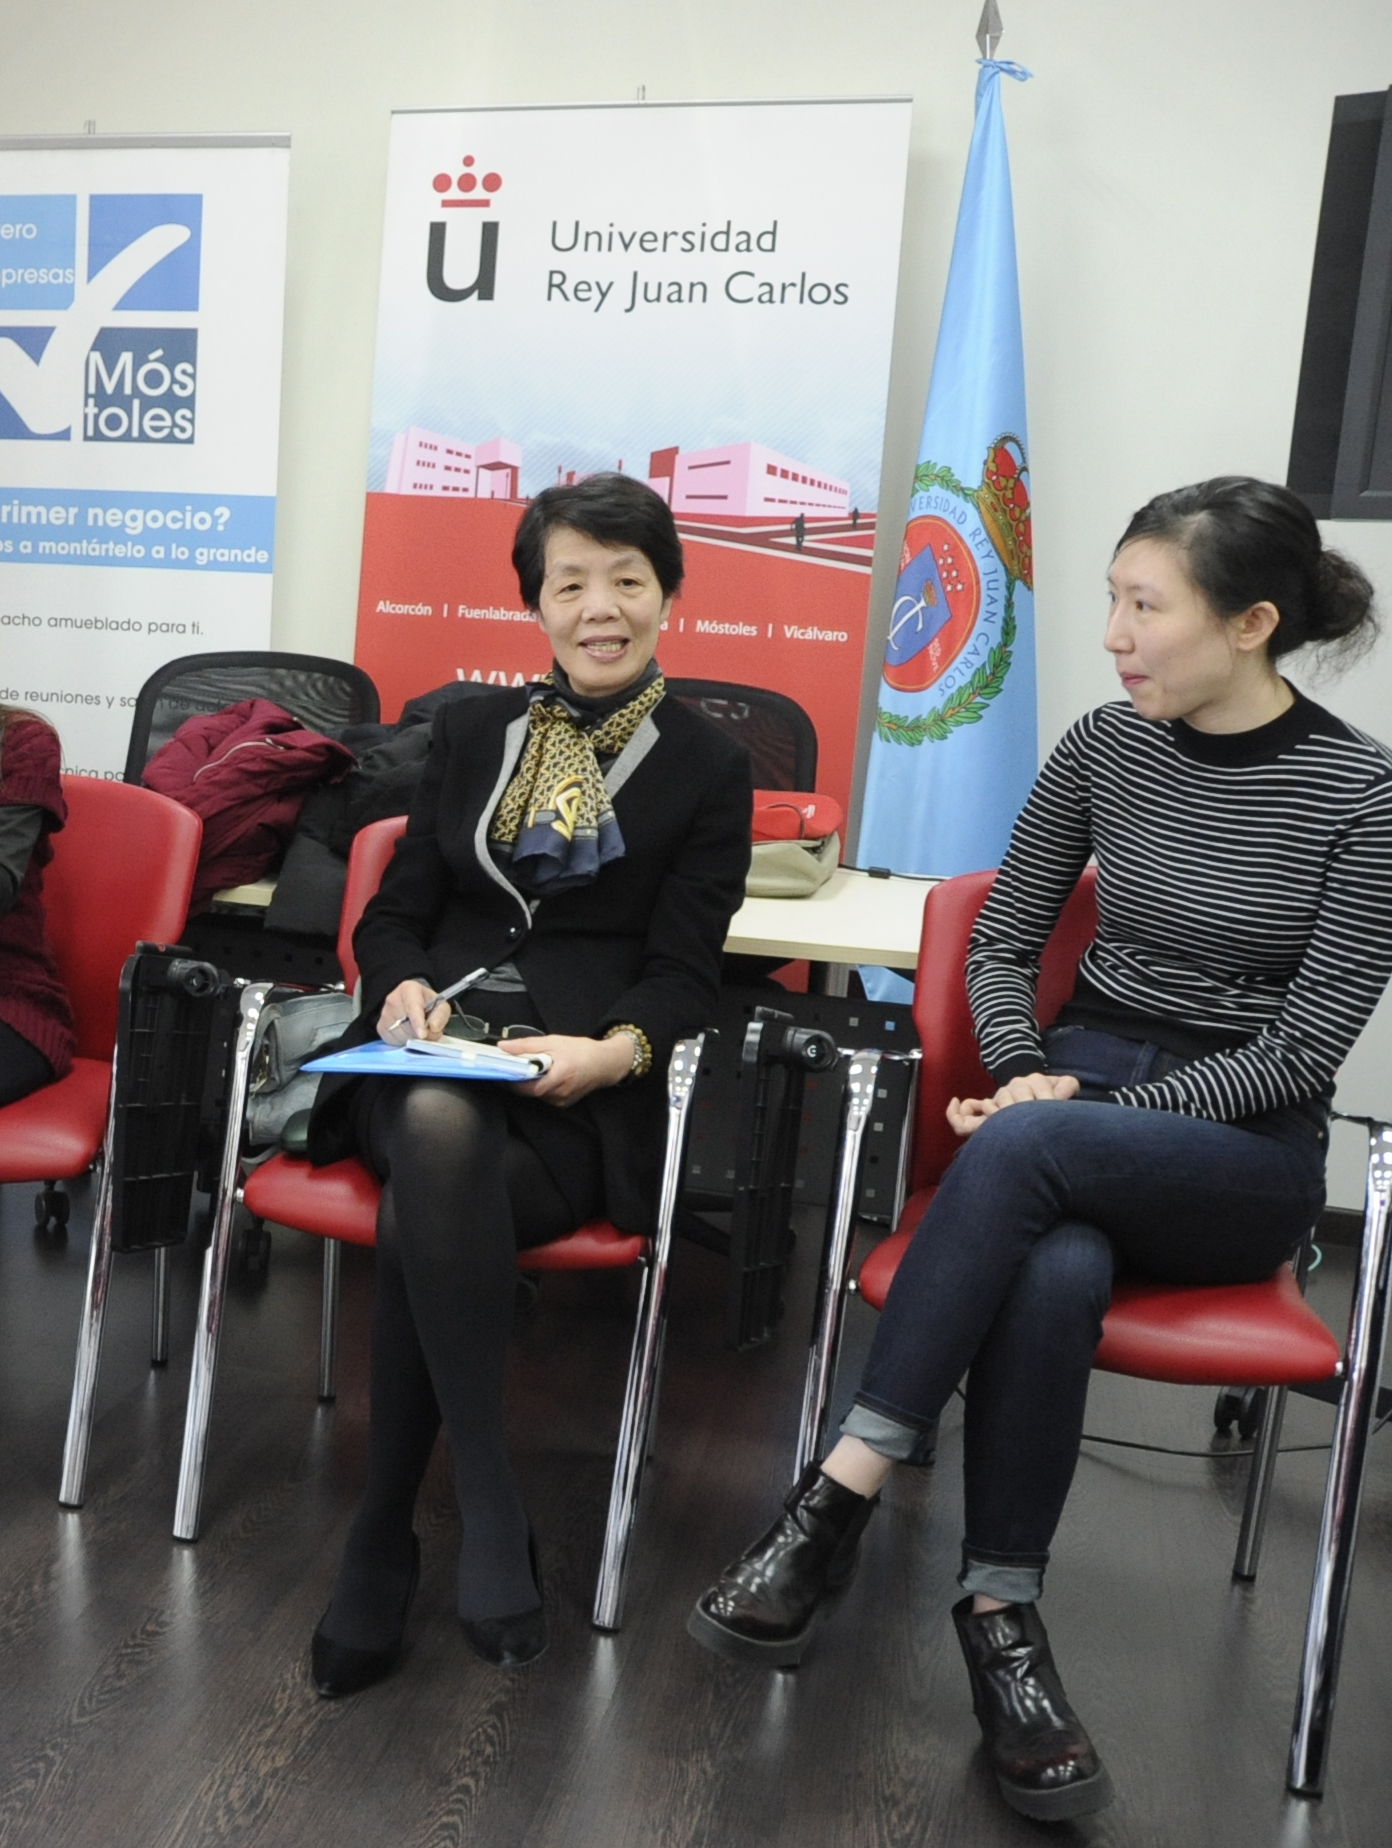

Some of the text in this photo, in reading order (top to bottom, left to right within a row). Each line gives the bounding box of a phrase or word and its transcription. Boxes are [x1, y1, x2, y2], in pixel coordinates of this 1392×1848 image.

[550, 219, 778, 254] Universidad
[546, 269, 850, 314] Rey Juan Carlos
[87, 348, 195, 398] Mós
[84, 397, 194, 441] toles
[87, 505, 231, 536] negocio?
[19, 540, 33, 554] a
[38, 538, 146, 559] montártelo
[151, 545, 165, 559] a
[171, 543, 189, 560] lo
[195, 546, 269, 566] grande
[911, 495, 999, 697] VERSIDAD REY JUAN CARLOS
[47, 616, 143, 632] amueblado
[147, 620, 187, 636] para
[191, 621, 205, 636] ti.
[375, 600, 849, 642] Alcorcón Fuenlabrada Móstoles Vicálvaro
[24, 689, 101, 706] reuniones
[105, 696, 115, 709] y
